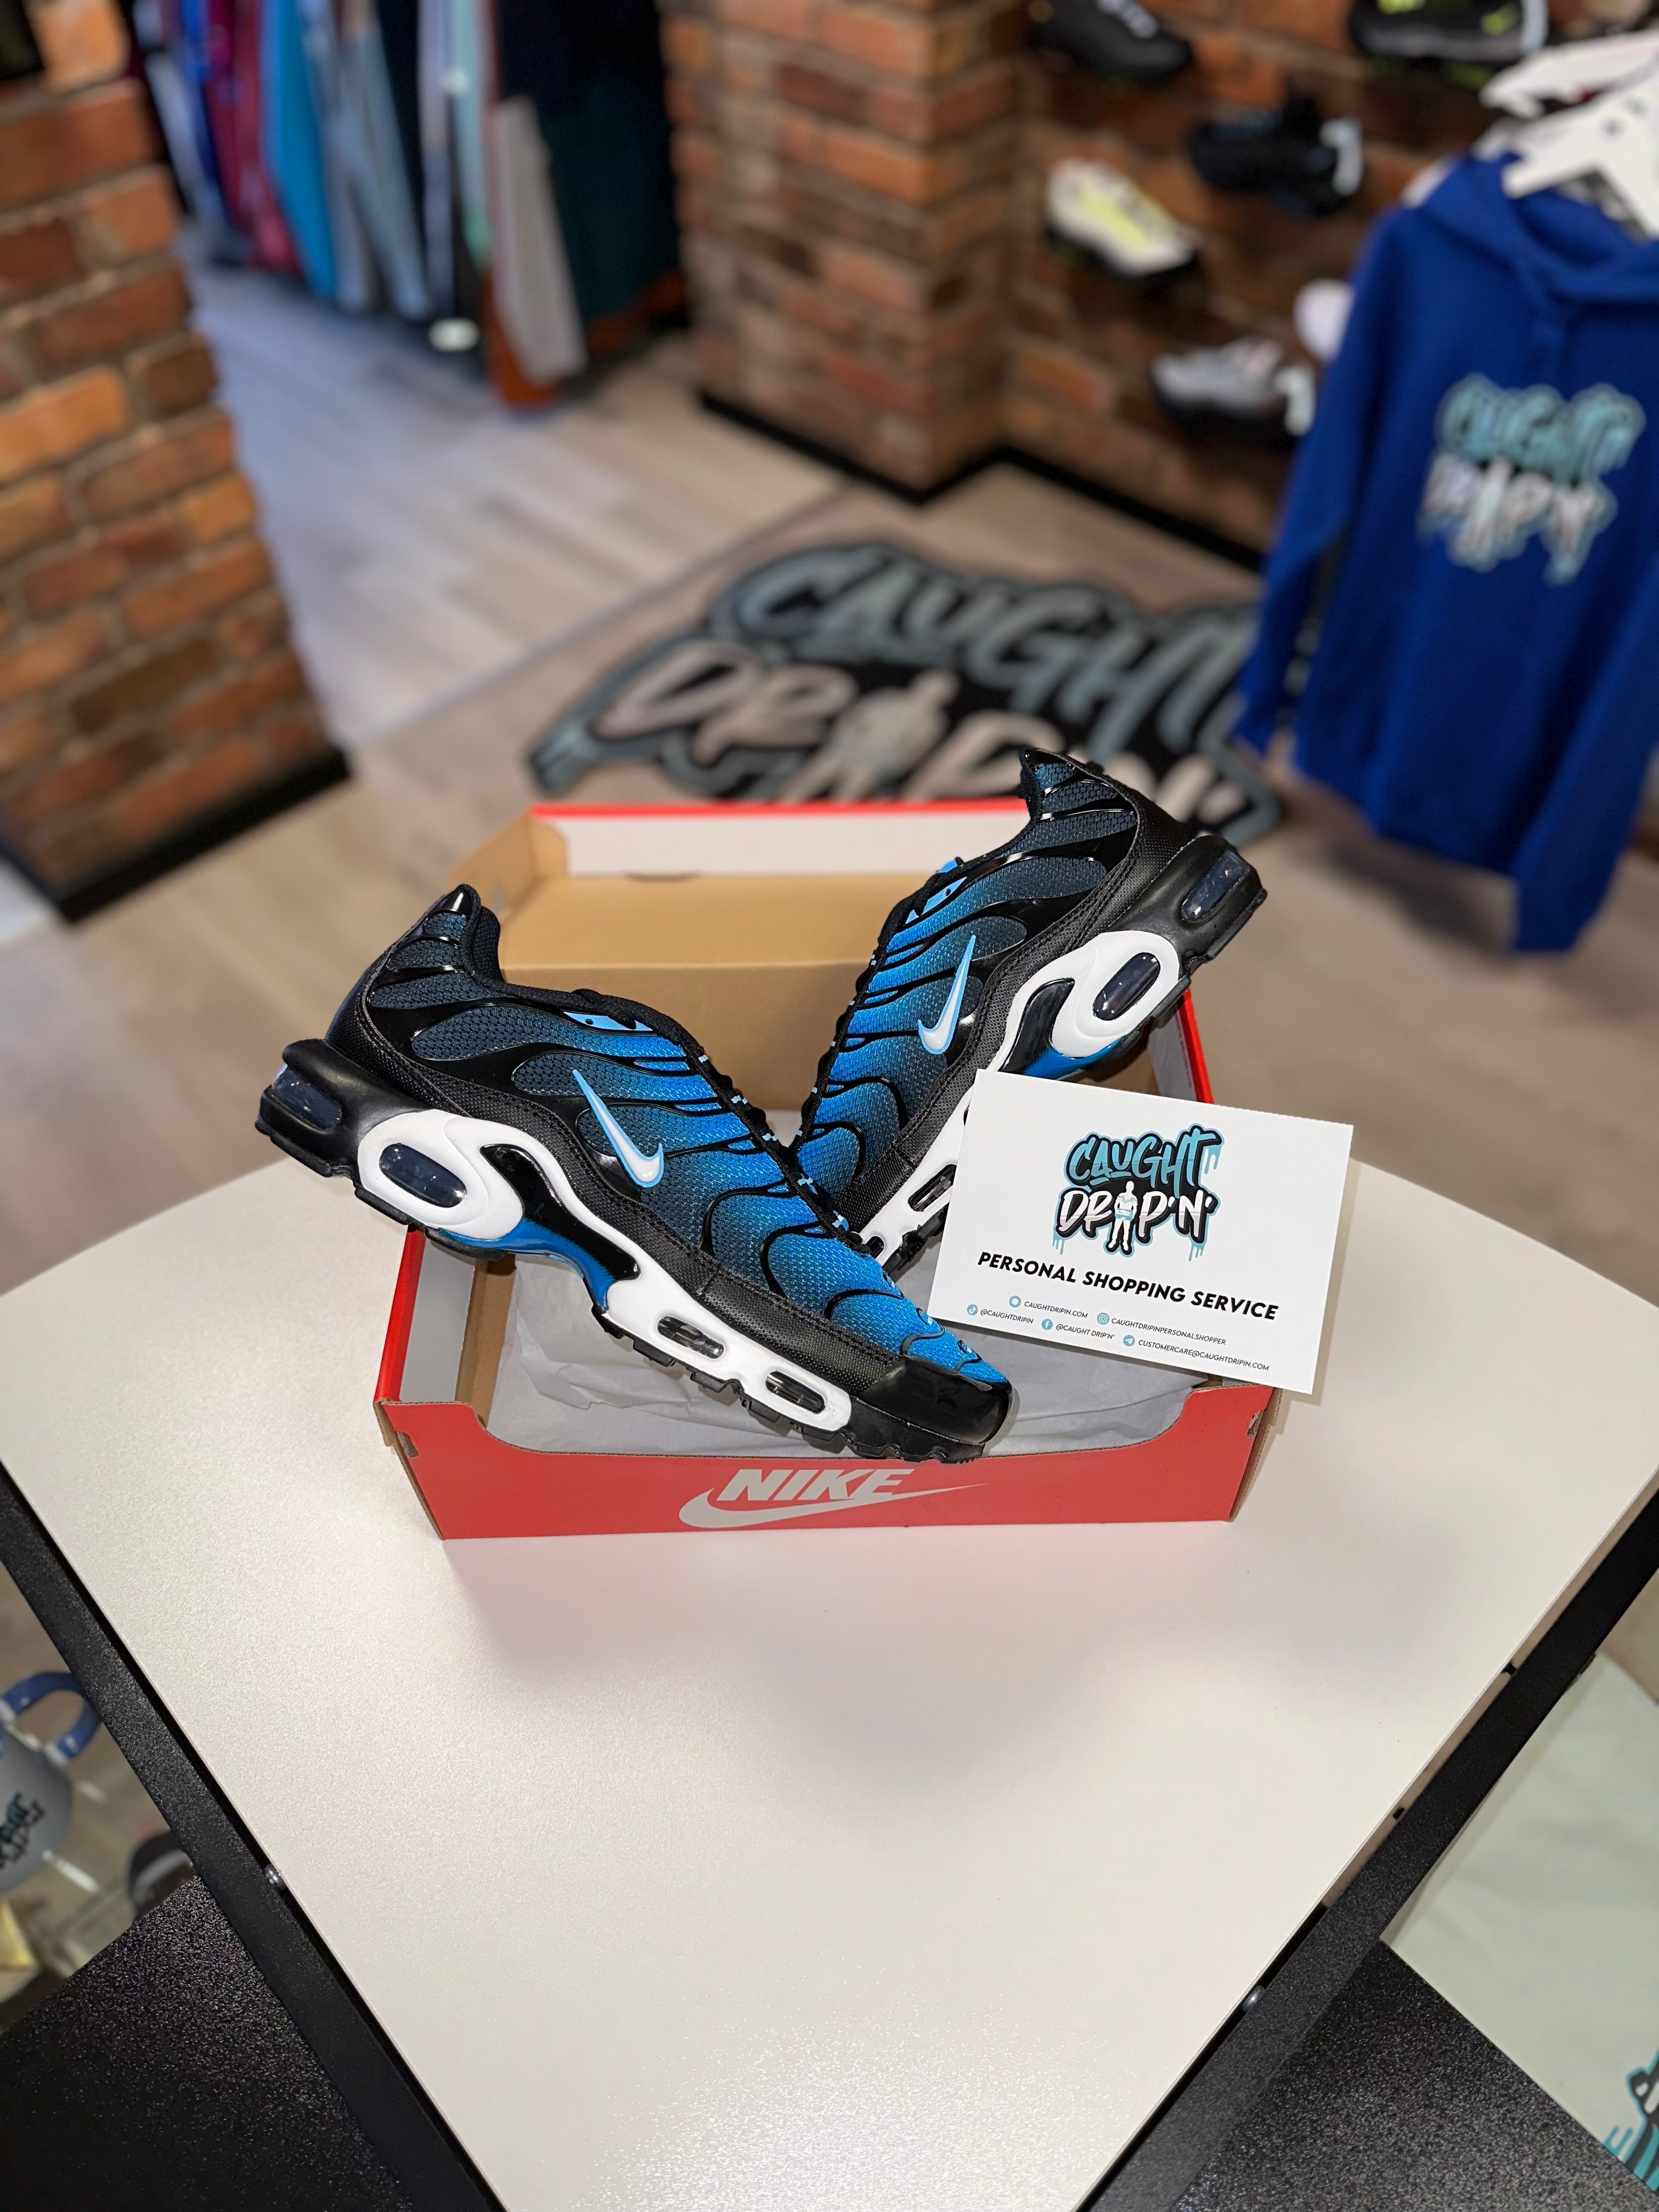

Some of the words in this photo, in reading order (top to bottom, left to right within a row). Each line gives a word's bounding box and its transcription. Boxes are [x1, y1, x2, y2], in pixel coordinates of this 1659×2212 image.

[1066, 1126, 1219, 1198] CAUGHT
[978, 1251, 1076, 1283] PERSONAL
[1082, 1271, 1186, 1302] SHOPPING
[1190, 1291, 1279, 1320] SERVICE
[980, 1308, 1034, 1324] @CAUGHTDRIPIN
[1024, 1301, 1088, 1318] CAUGHTDRIPIN.COM
[1056, 1323, 1091, 1335] @CAUGHT
[1111, 1318, 1226, 1345] CAUGHTDRIPINPERSONALSHOPPER
[1138, 1340, 1269, 1371] CUSTOMERCARE@CAUGHTDRIPIN.COM
[716, 1468, 916, 1500] NIKE
